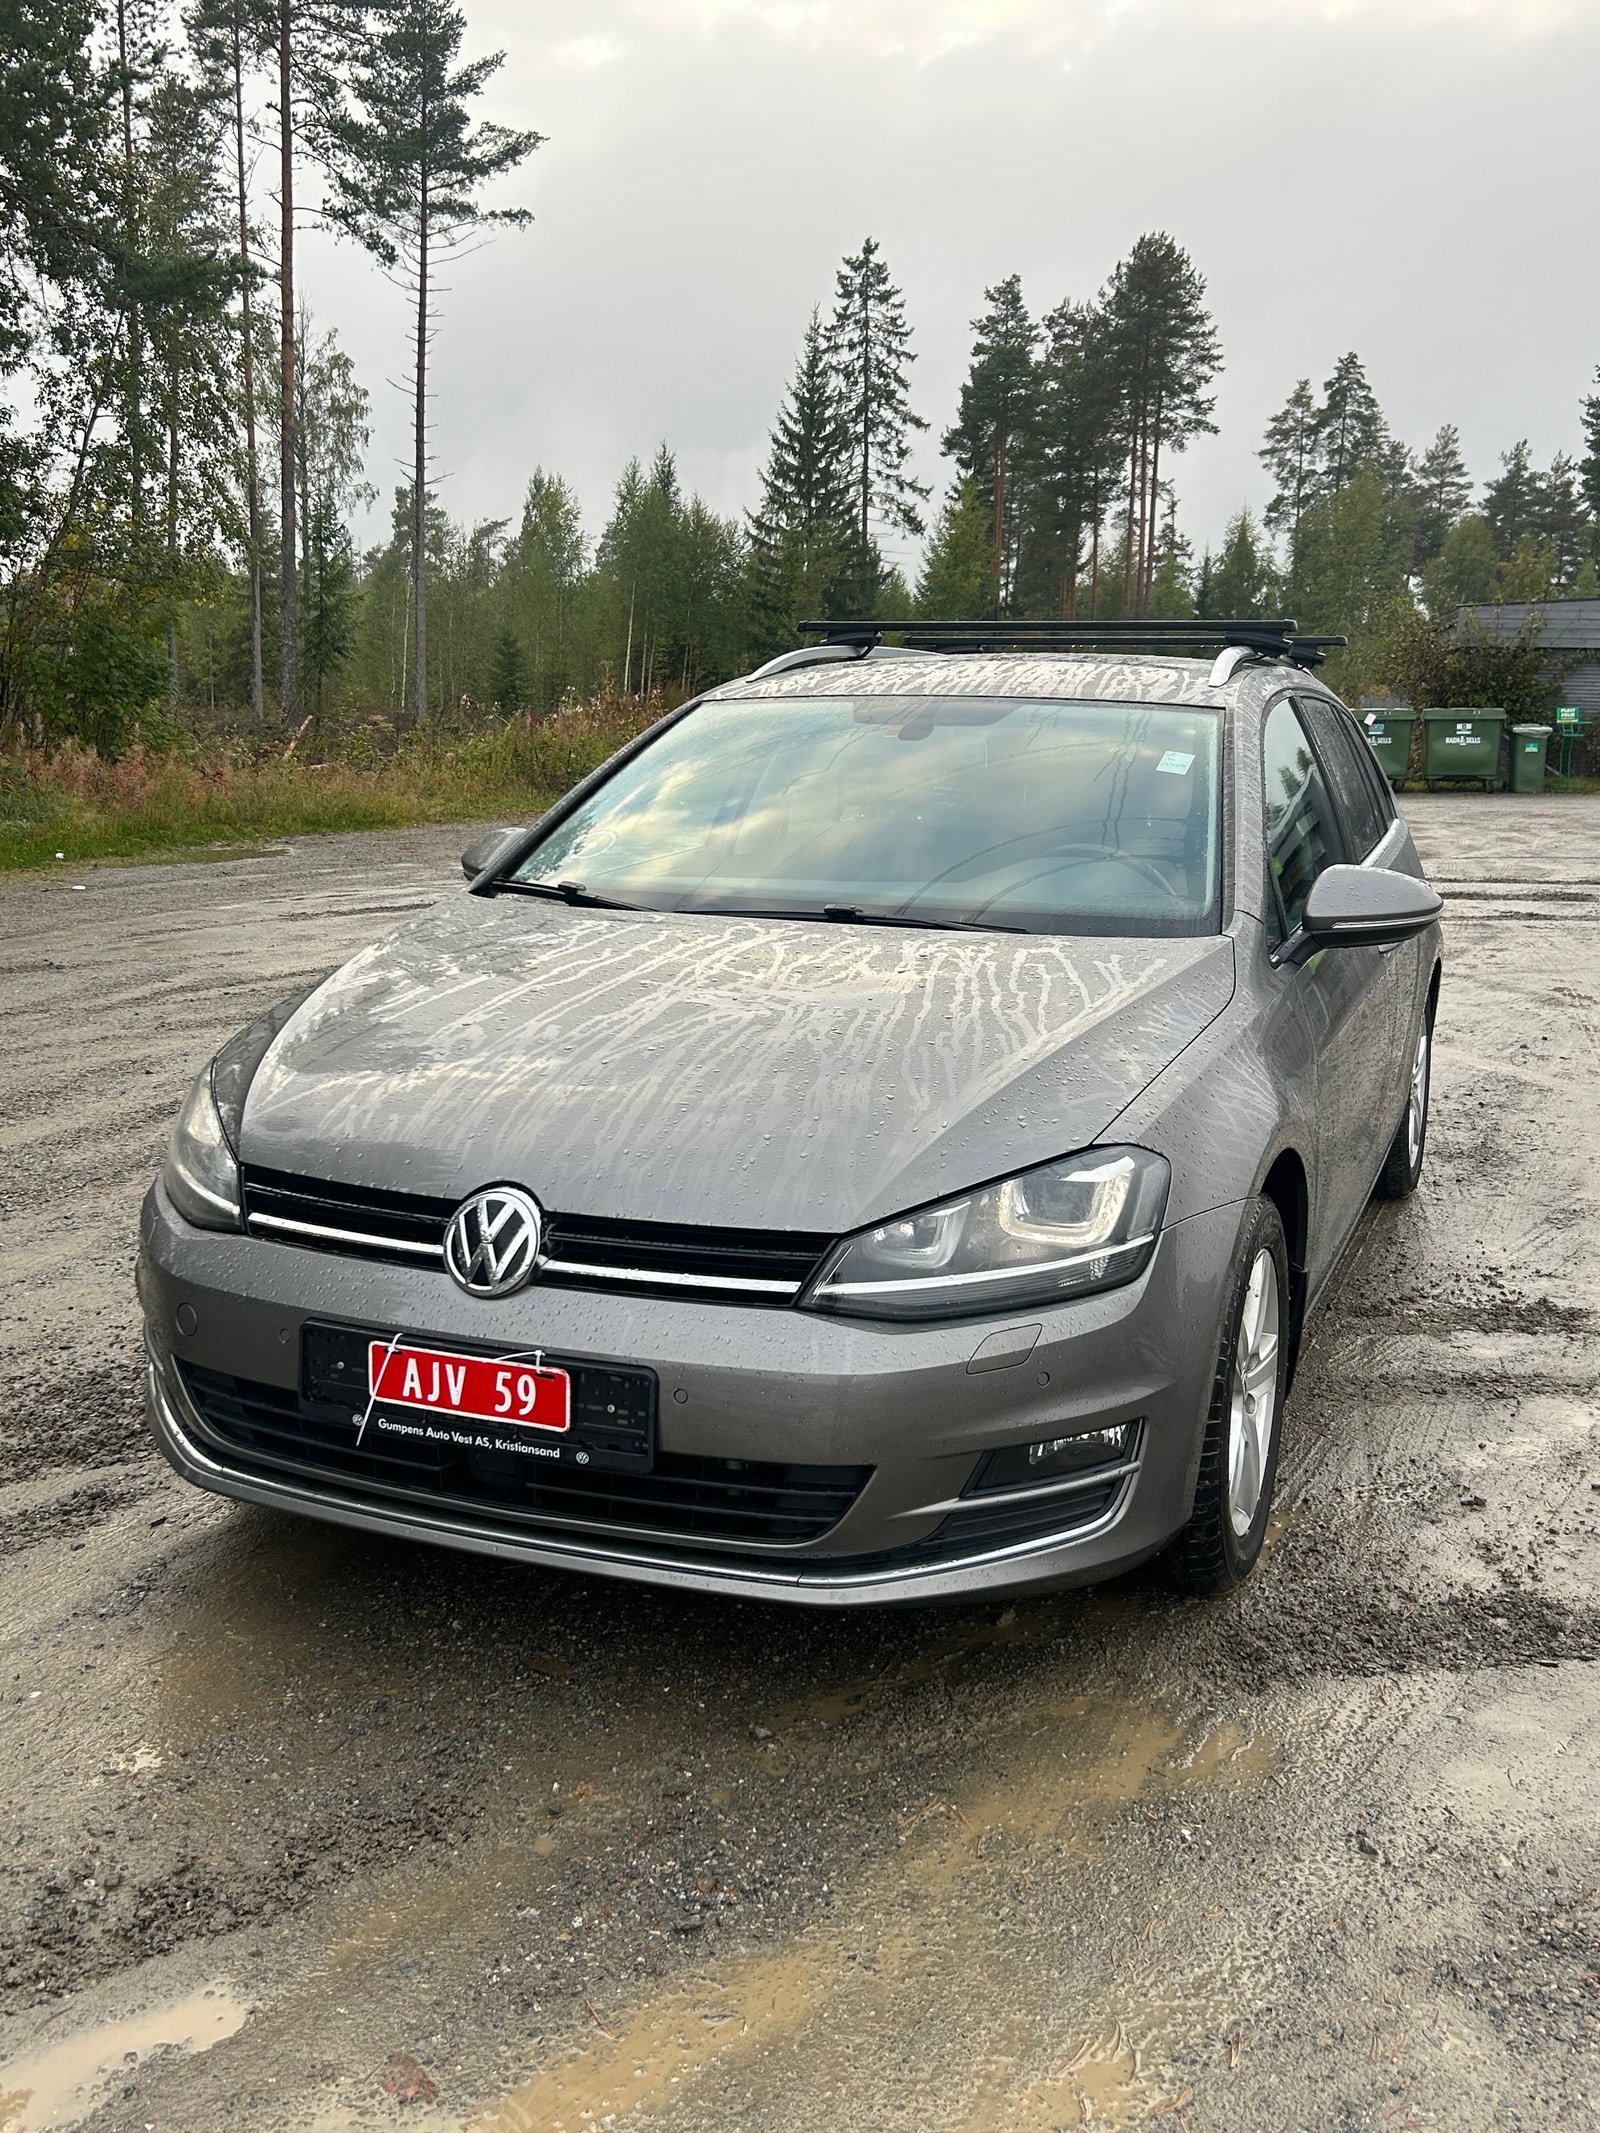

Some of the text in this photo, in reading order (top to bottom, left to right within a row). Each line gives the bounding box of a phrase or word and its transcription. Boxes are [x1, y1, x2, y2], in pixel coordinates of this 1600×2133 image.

[402, 1358, 537, 1415] AJV 59
[378, 1418, 560, 1459] Gumpens Auto Vest AS, Kristiansand
